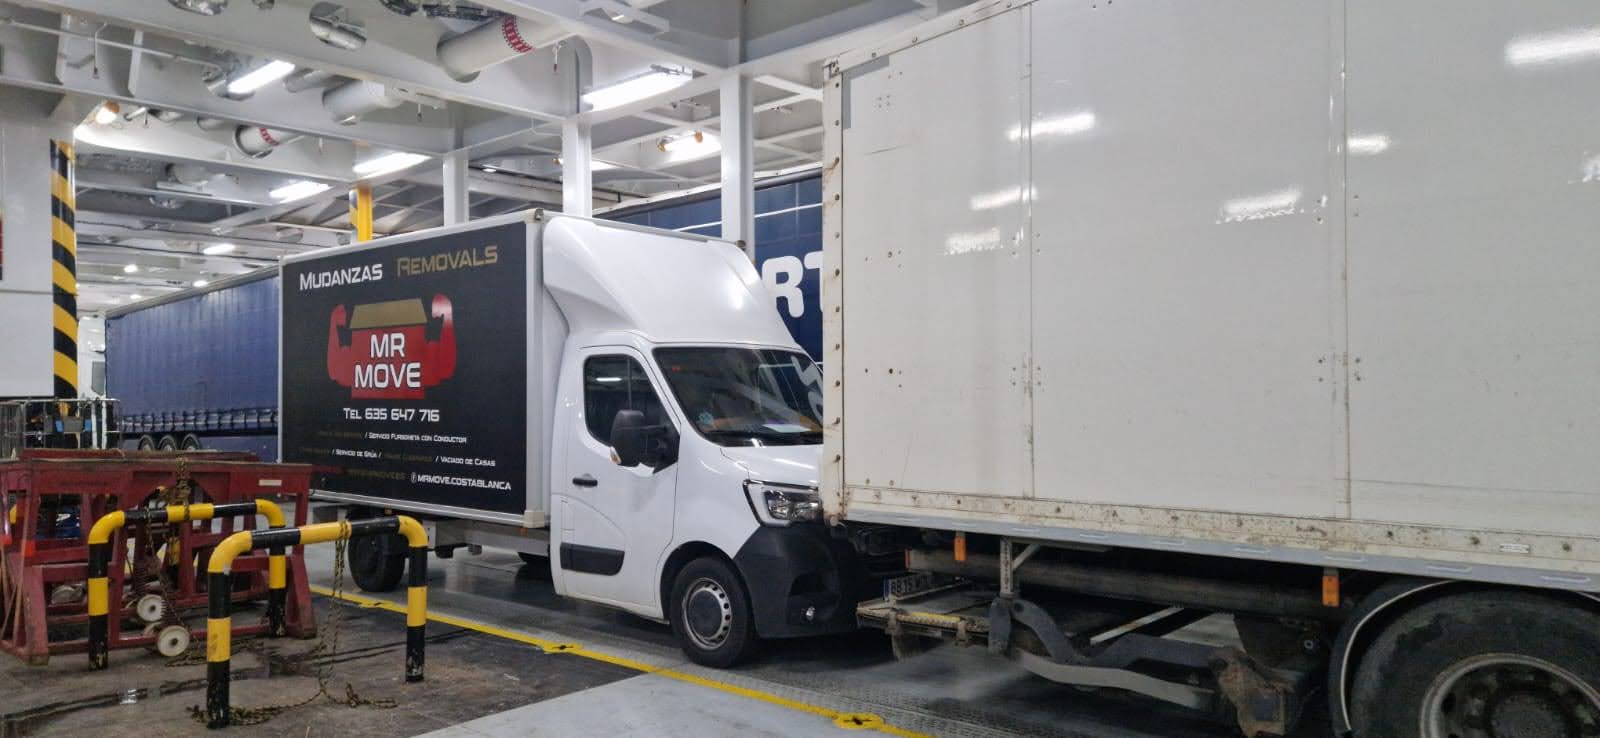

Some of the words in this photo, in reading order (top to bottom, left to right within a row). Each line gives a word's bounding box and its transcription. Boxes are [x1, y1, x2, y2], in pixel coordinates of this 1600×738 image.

[299, 263, 383, 291] MUDANZAS
[397, 245, 499, 278] REMOVALS
[371, 333, 405, 358] MR
[355, 362, 421, 388] MOVE
[343, 407, 362, 420] TEL
[365, 408, 388, 421] 635
[391, 409, 415, 422] 647
[418, 409, 440, 423] 716
